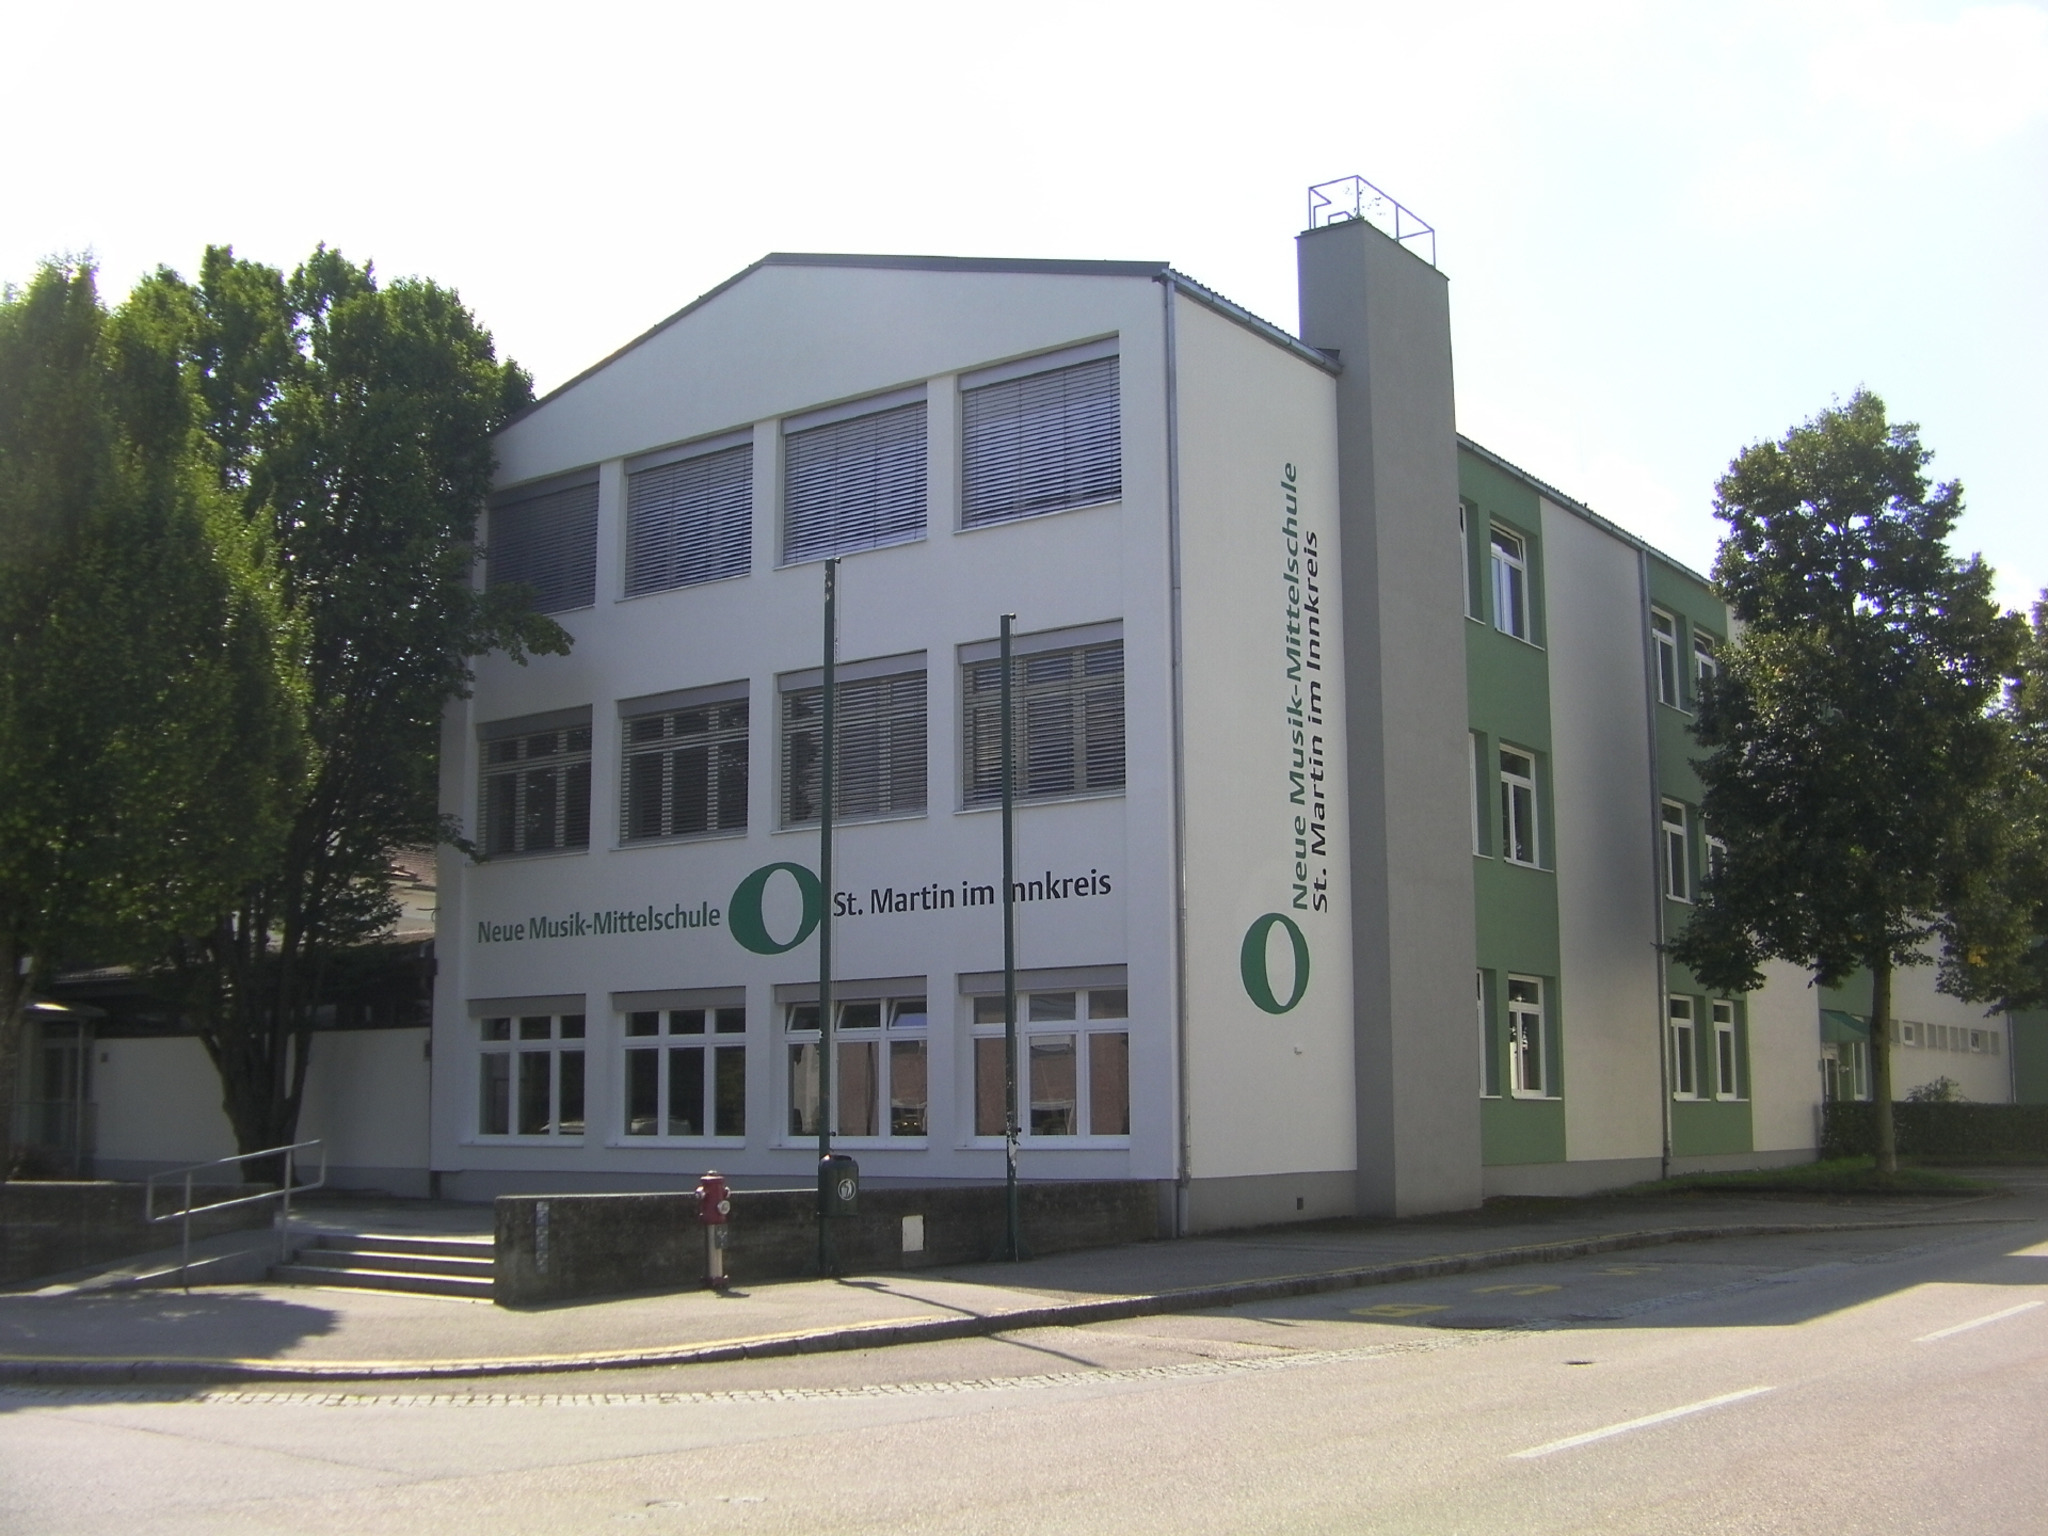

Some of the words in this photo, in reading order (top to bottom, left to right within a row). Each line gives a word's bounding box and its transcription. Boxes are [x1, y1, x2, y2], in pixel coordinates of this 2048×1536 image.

[1280, 462, 1306, 806] Musik-Mittelschule
[1303, 531, 1321, 671] Innkreis
[1307, 680, 1323, 725] im
[1309, 735, 1327, 856] Martin
[478, 921, 525, 944] Neue
[529, 901, 721, 940] Musik-Mittelschule
[832, 891, 864, 917] St.
[871, 883, 955, 914] Martin
[962, 880, 995, 907] im
[1004, 868, 1112, 906] nnkreis
[1292, 815, 1308, 911] Neue
[1312, 867, 1328, 913] St.
